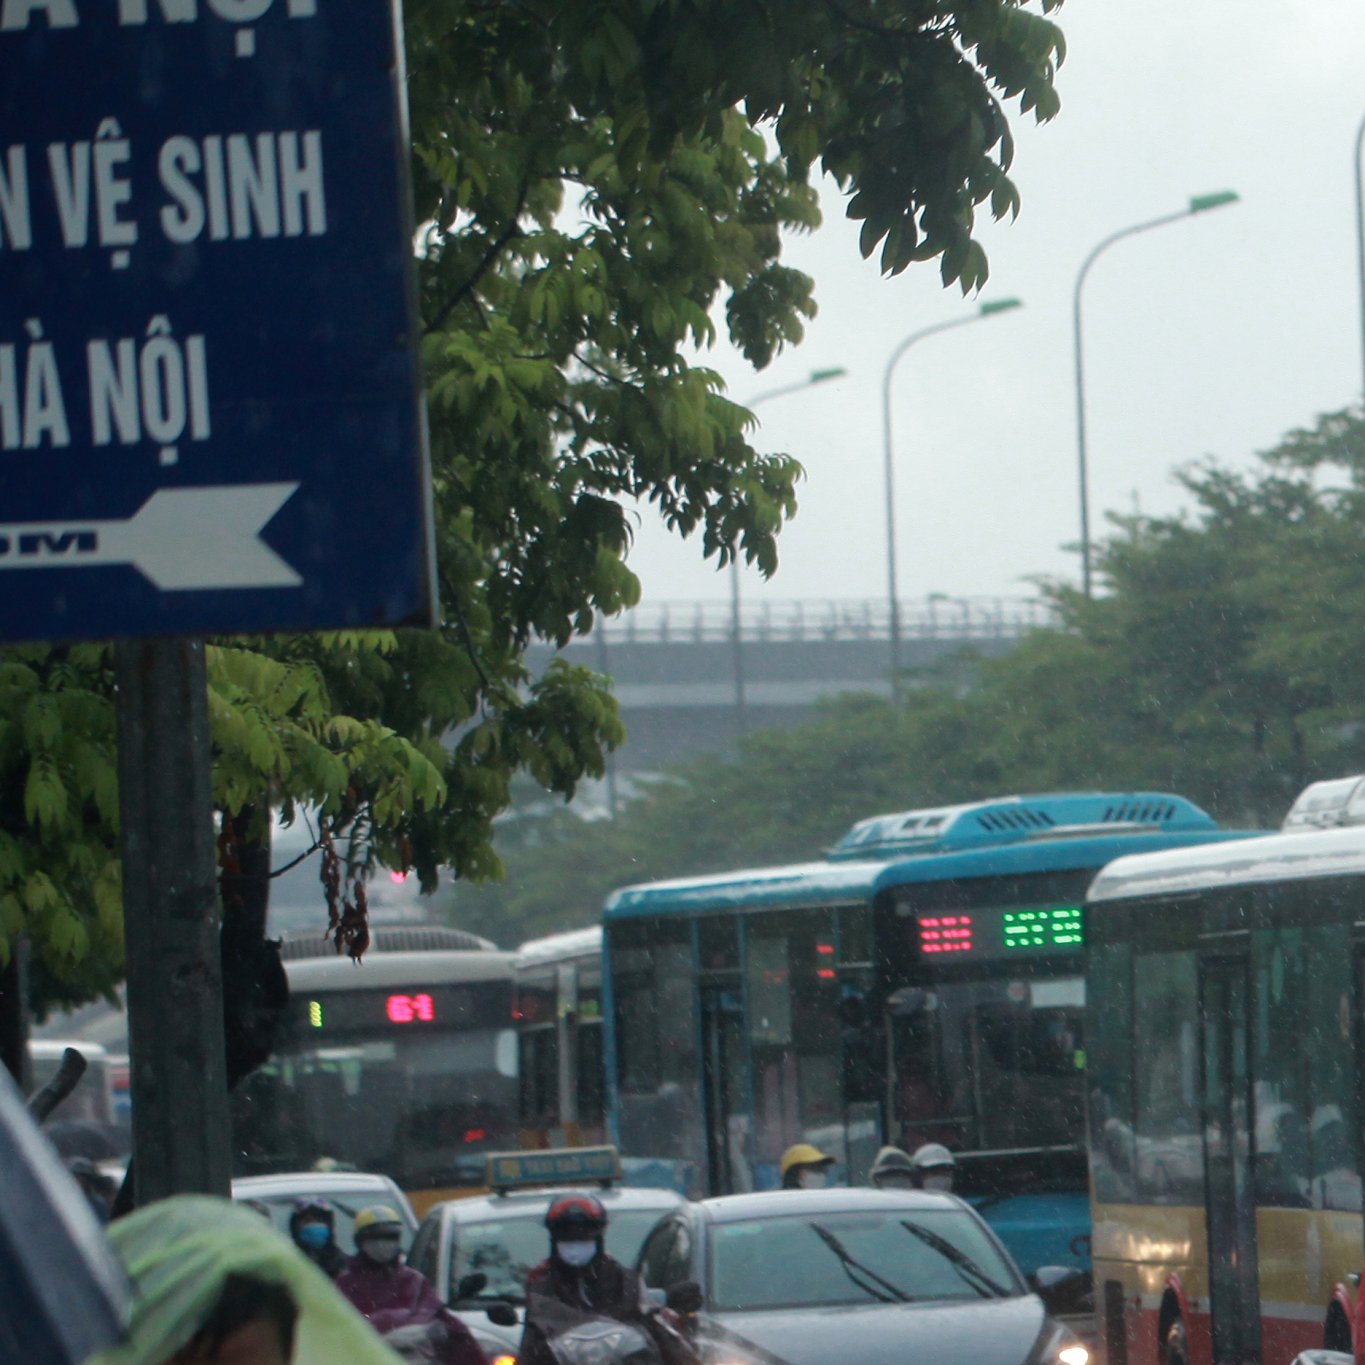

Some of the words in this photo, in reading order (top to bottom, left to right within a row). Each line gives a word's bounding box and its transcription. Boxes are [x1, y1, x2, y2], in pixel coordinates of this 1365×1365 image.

[47, 116, 138, 270] VỆ
[158, 129, 327, 244] SINH
[87, 313, 211, 466] NỘI
